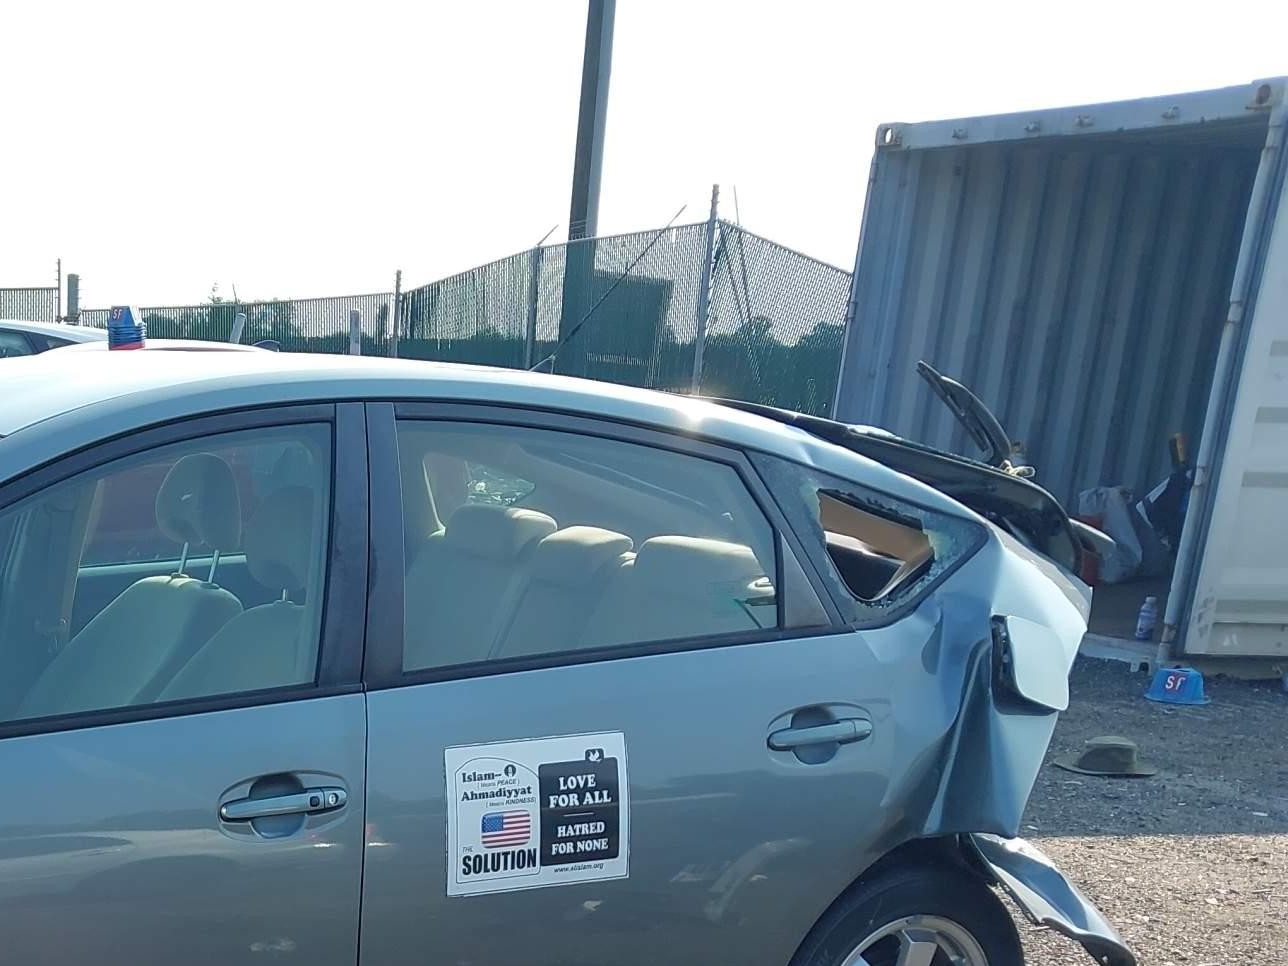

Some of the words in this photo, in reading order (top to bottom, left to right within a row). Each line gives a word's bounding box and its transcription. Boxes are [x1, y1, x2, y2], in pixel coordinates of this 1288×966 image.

[559, 774, 596, 790] LOVE
[461, 785, 532, 801] Ahmadiyyat
[549, 793, 579, 808] FOR
[583, 790, 612, 805] ALL
[557, 821, 605, 837] HATRED
[551, 842, 574, 856] FOR
[576, 838, 609, 853] NONE
[462, 848, 537, 876] SOLUTION
